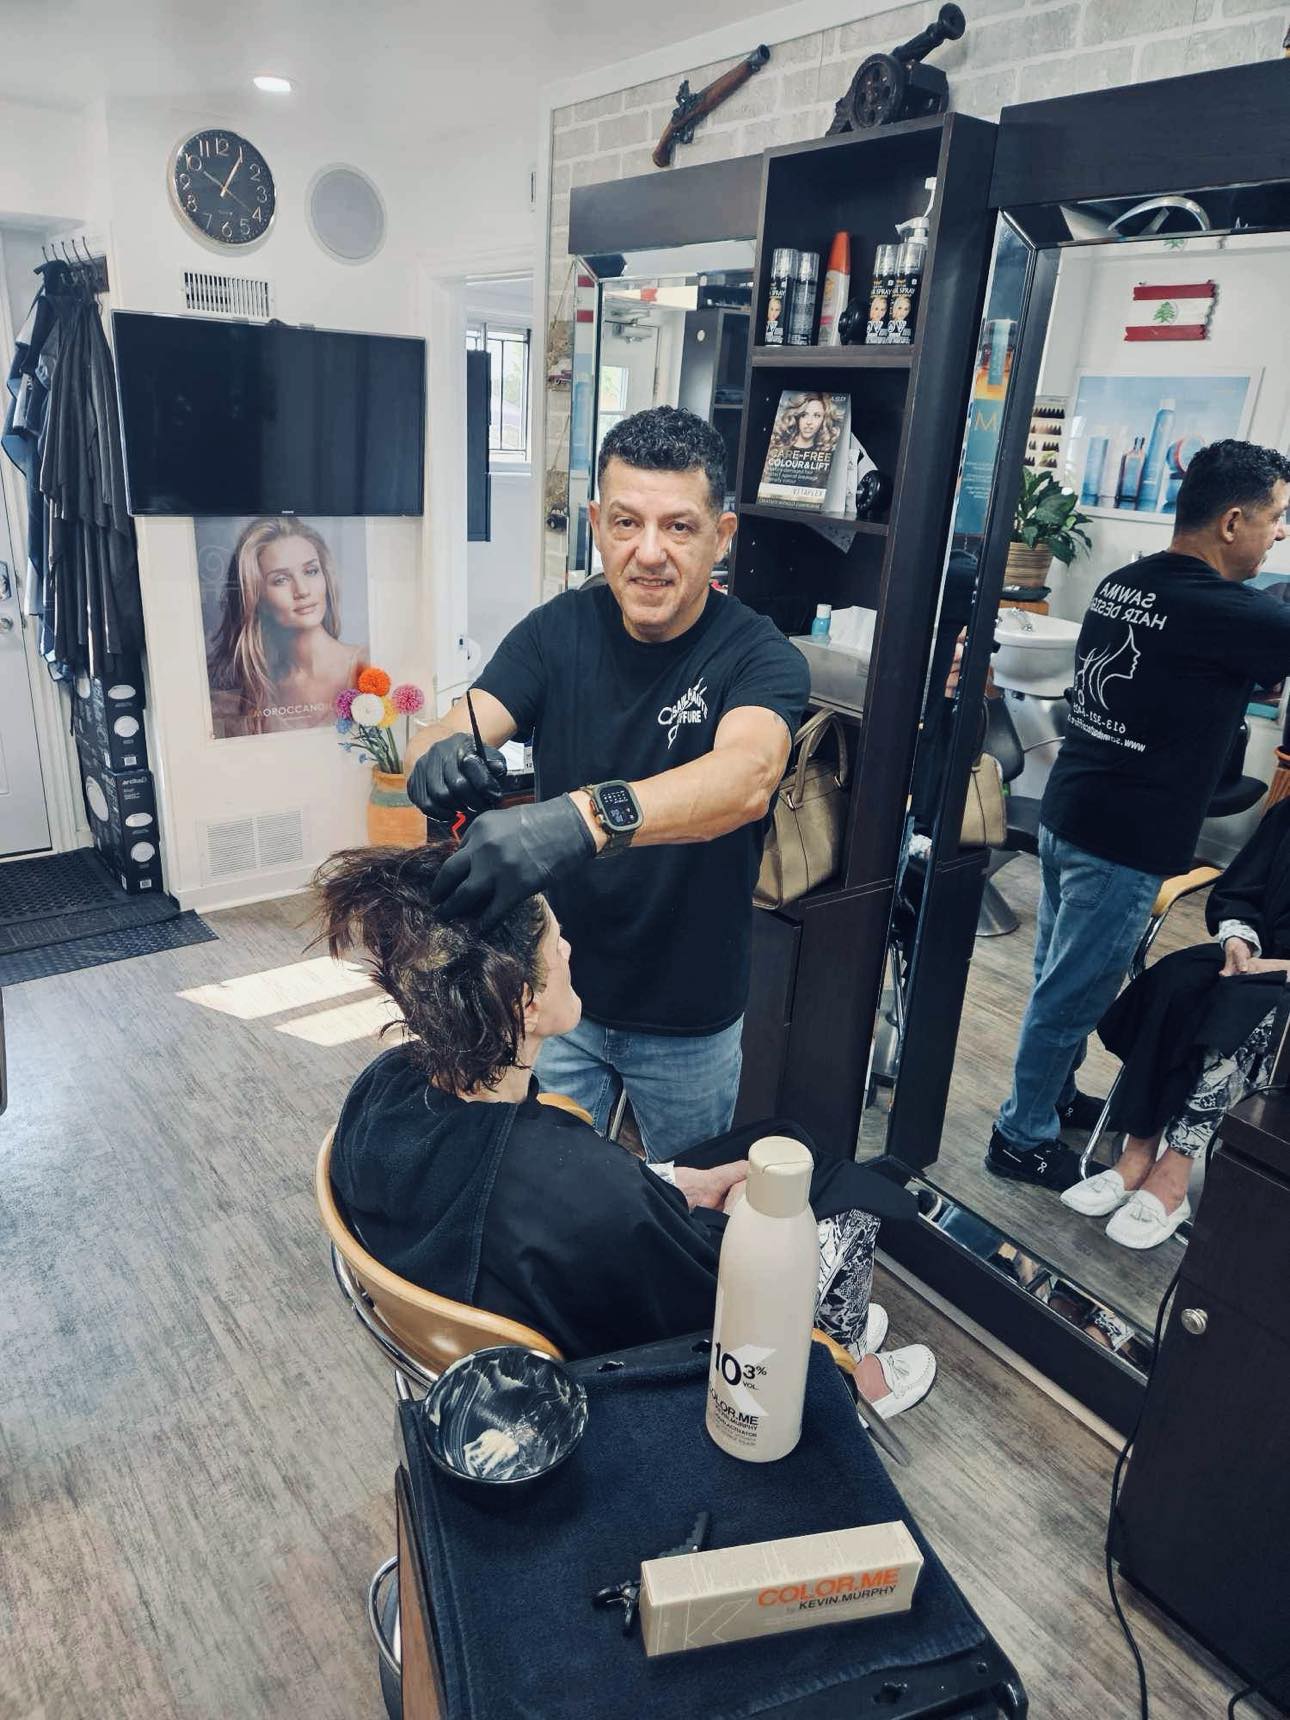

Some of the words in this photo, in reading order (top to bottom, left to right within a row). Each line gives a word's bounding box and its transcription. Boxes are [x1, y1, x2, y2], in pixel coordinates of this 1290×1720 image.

[200, 139, 211, 158] 11
[215, 137, 230, 157] 12
[185, 152, 203, 172] 10
[179, 173, 191, 191] 9
[249, 163, 261, 182] 2
[186, 194, 198, 213] 8
[256, 185, 268, 204] 3
[202, 212, 213, 230] 7
[251, 206, 262, 223] 4
[221, 221, 233, 238] 6
[240, 218, 251, 236] 5
[771, 449, 833, 462] CARE-FREE
[715, 1341, 742, 1386] 10
[743, 1364, 767, 1380] 3%
[757, 1567, 899, 1607] COLOR.ME
[799, 1584, 897, 1610] KEVIN.MURPHY
